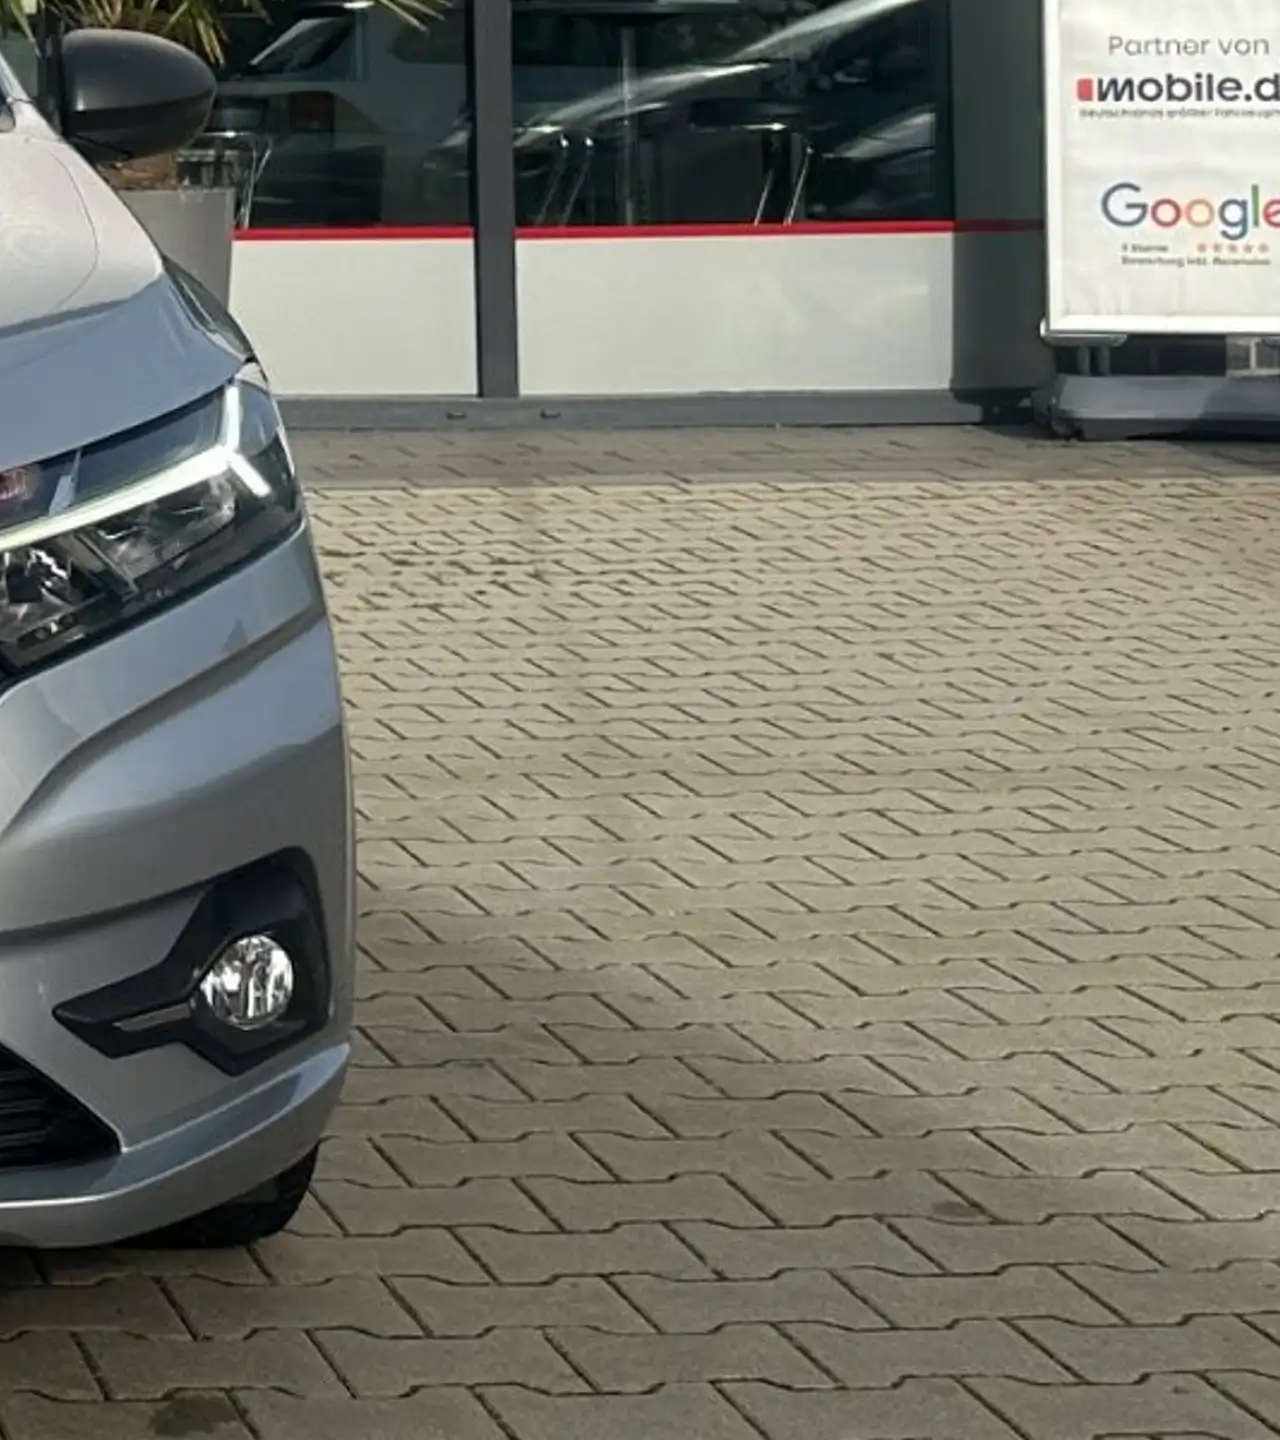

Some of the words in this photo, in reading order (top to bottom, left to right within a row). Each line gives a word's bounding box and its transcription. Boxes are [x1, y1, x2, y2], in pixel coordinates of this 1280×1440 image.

[1108, 35, 1211, 57] Partner
[1217, 39, 1270, 56] von
[1100, 182, 1280, 241] Google
